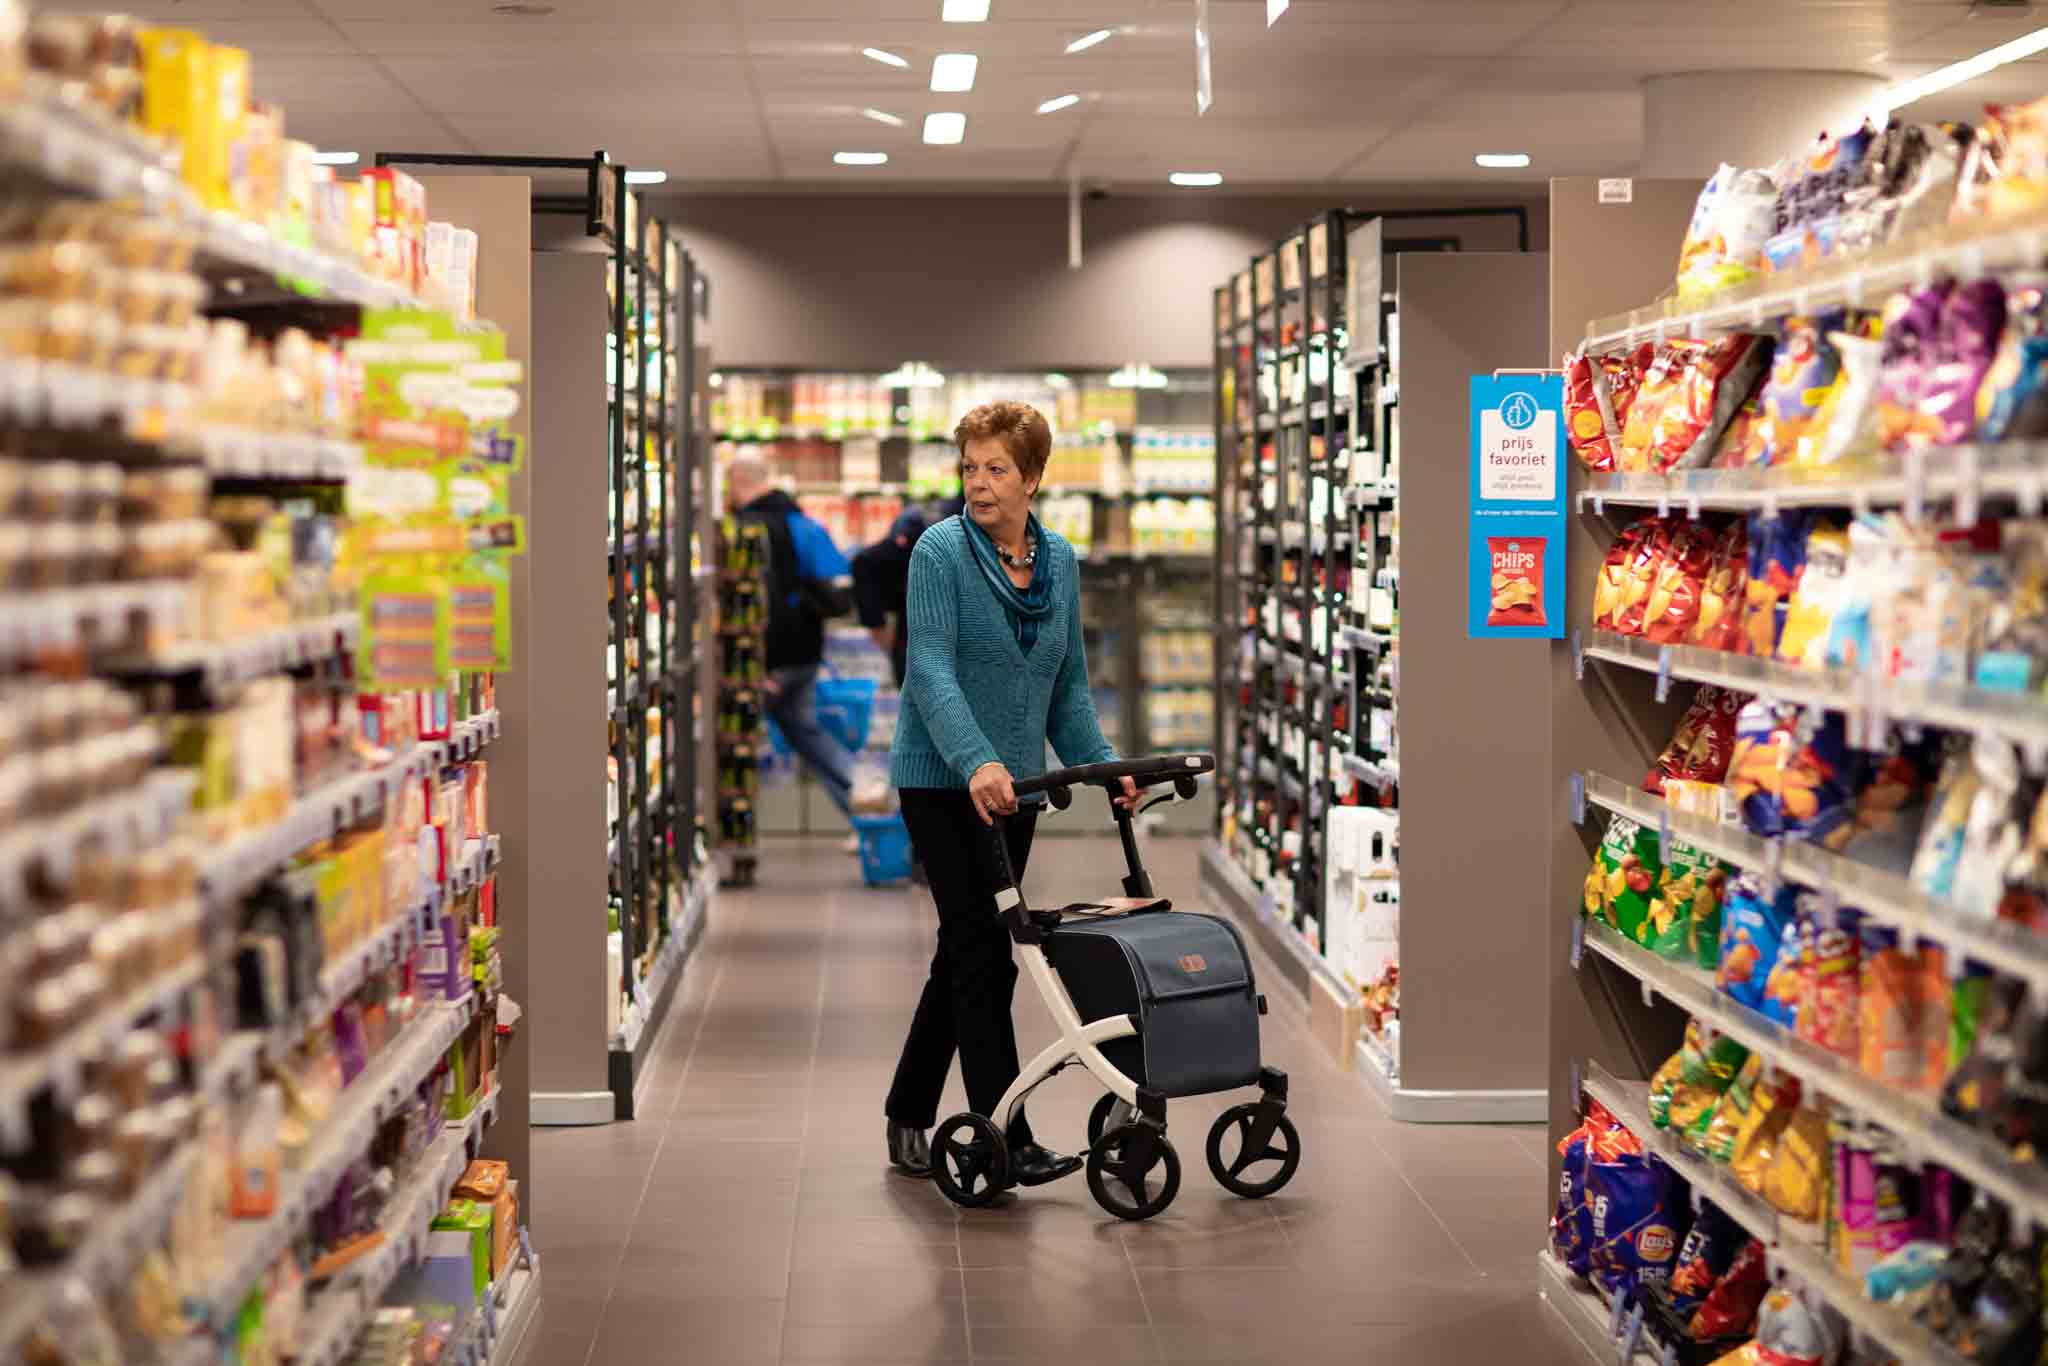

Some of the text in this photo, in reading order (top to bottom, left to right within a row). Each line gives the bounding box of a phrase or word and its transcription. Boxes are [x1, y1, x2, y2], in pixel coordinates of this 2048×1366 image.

[1501, 435, 1534, 452] prijs
[1489, 451, 1546, 466] favoriet
[1493, 552, 1536, 568] CHIPS
